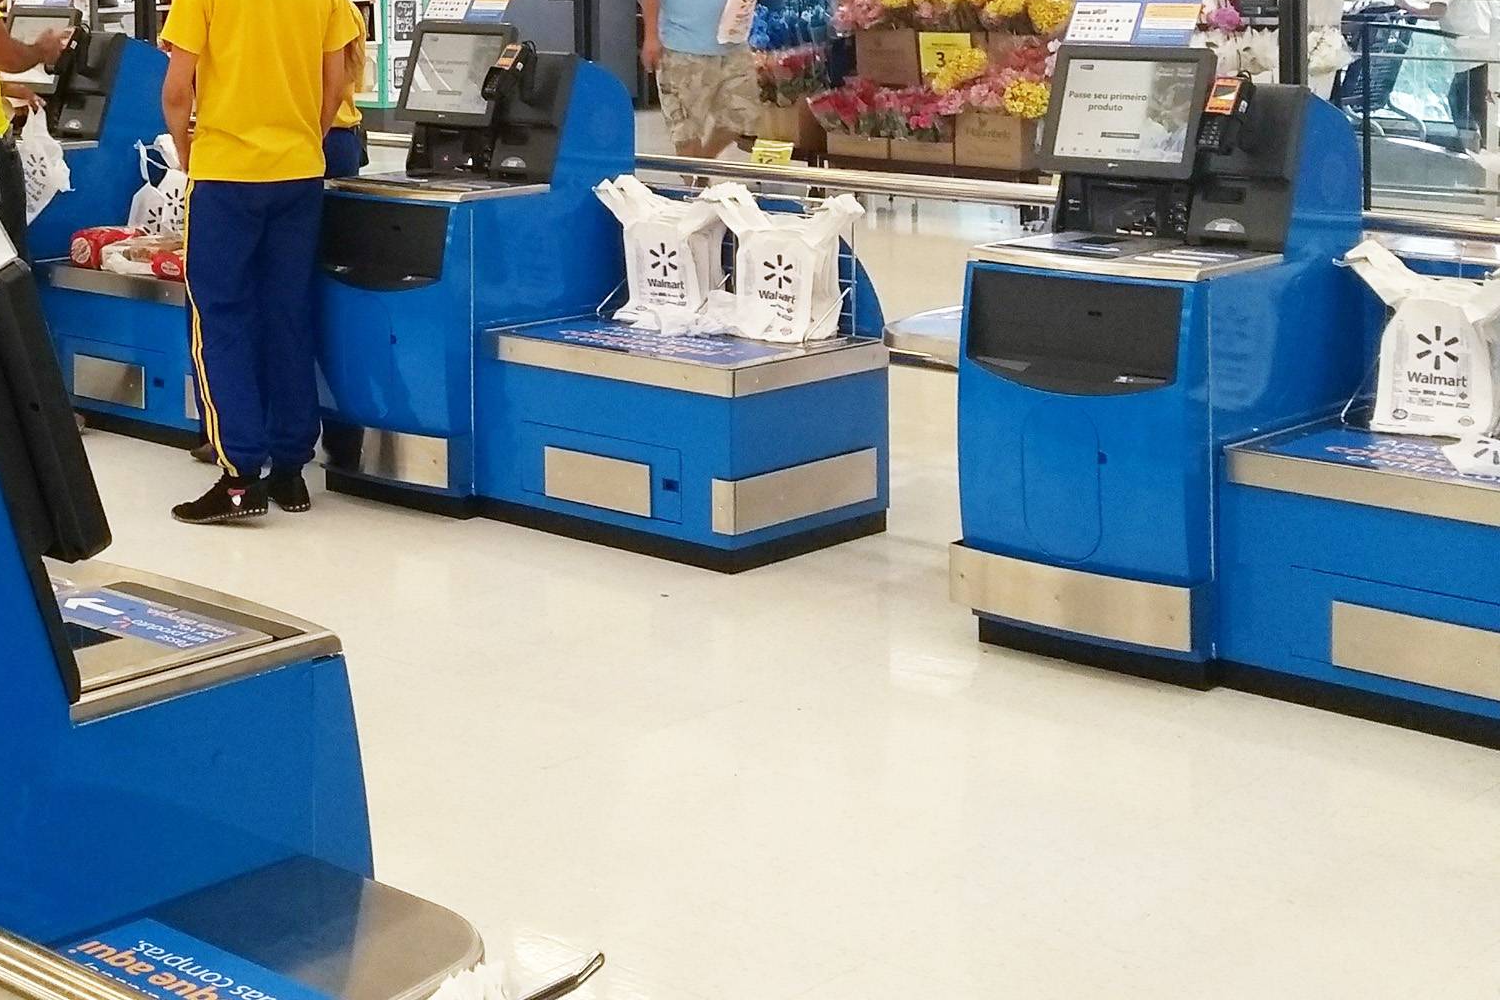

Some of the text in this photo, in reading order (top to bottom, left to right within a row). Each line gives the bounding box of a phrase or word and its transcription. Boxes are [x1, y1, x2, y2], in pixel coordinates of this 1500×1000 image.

[1068, 90, 1148, 102] Passe seu primeiro
[1087, 102, 1124, 112] produto
[647, 277, 685, 291] Walmart
[1407, 370, 1468, 388] Walmart
[68, 940, 156, 976] aqui
[132, 940, 235, 989] compras.
